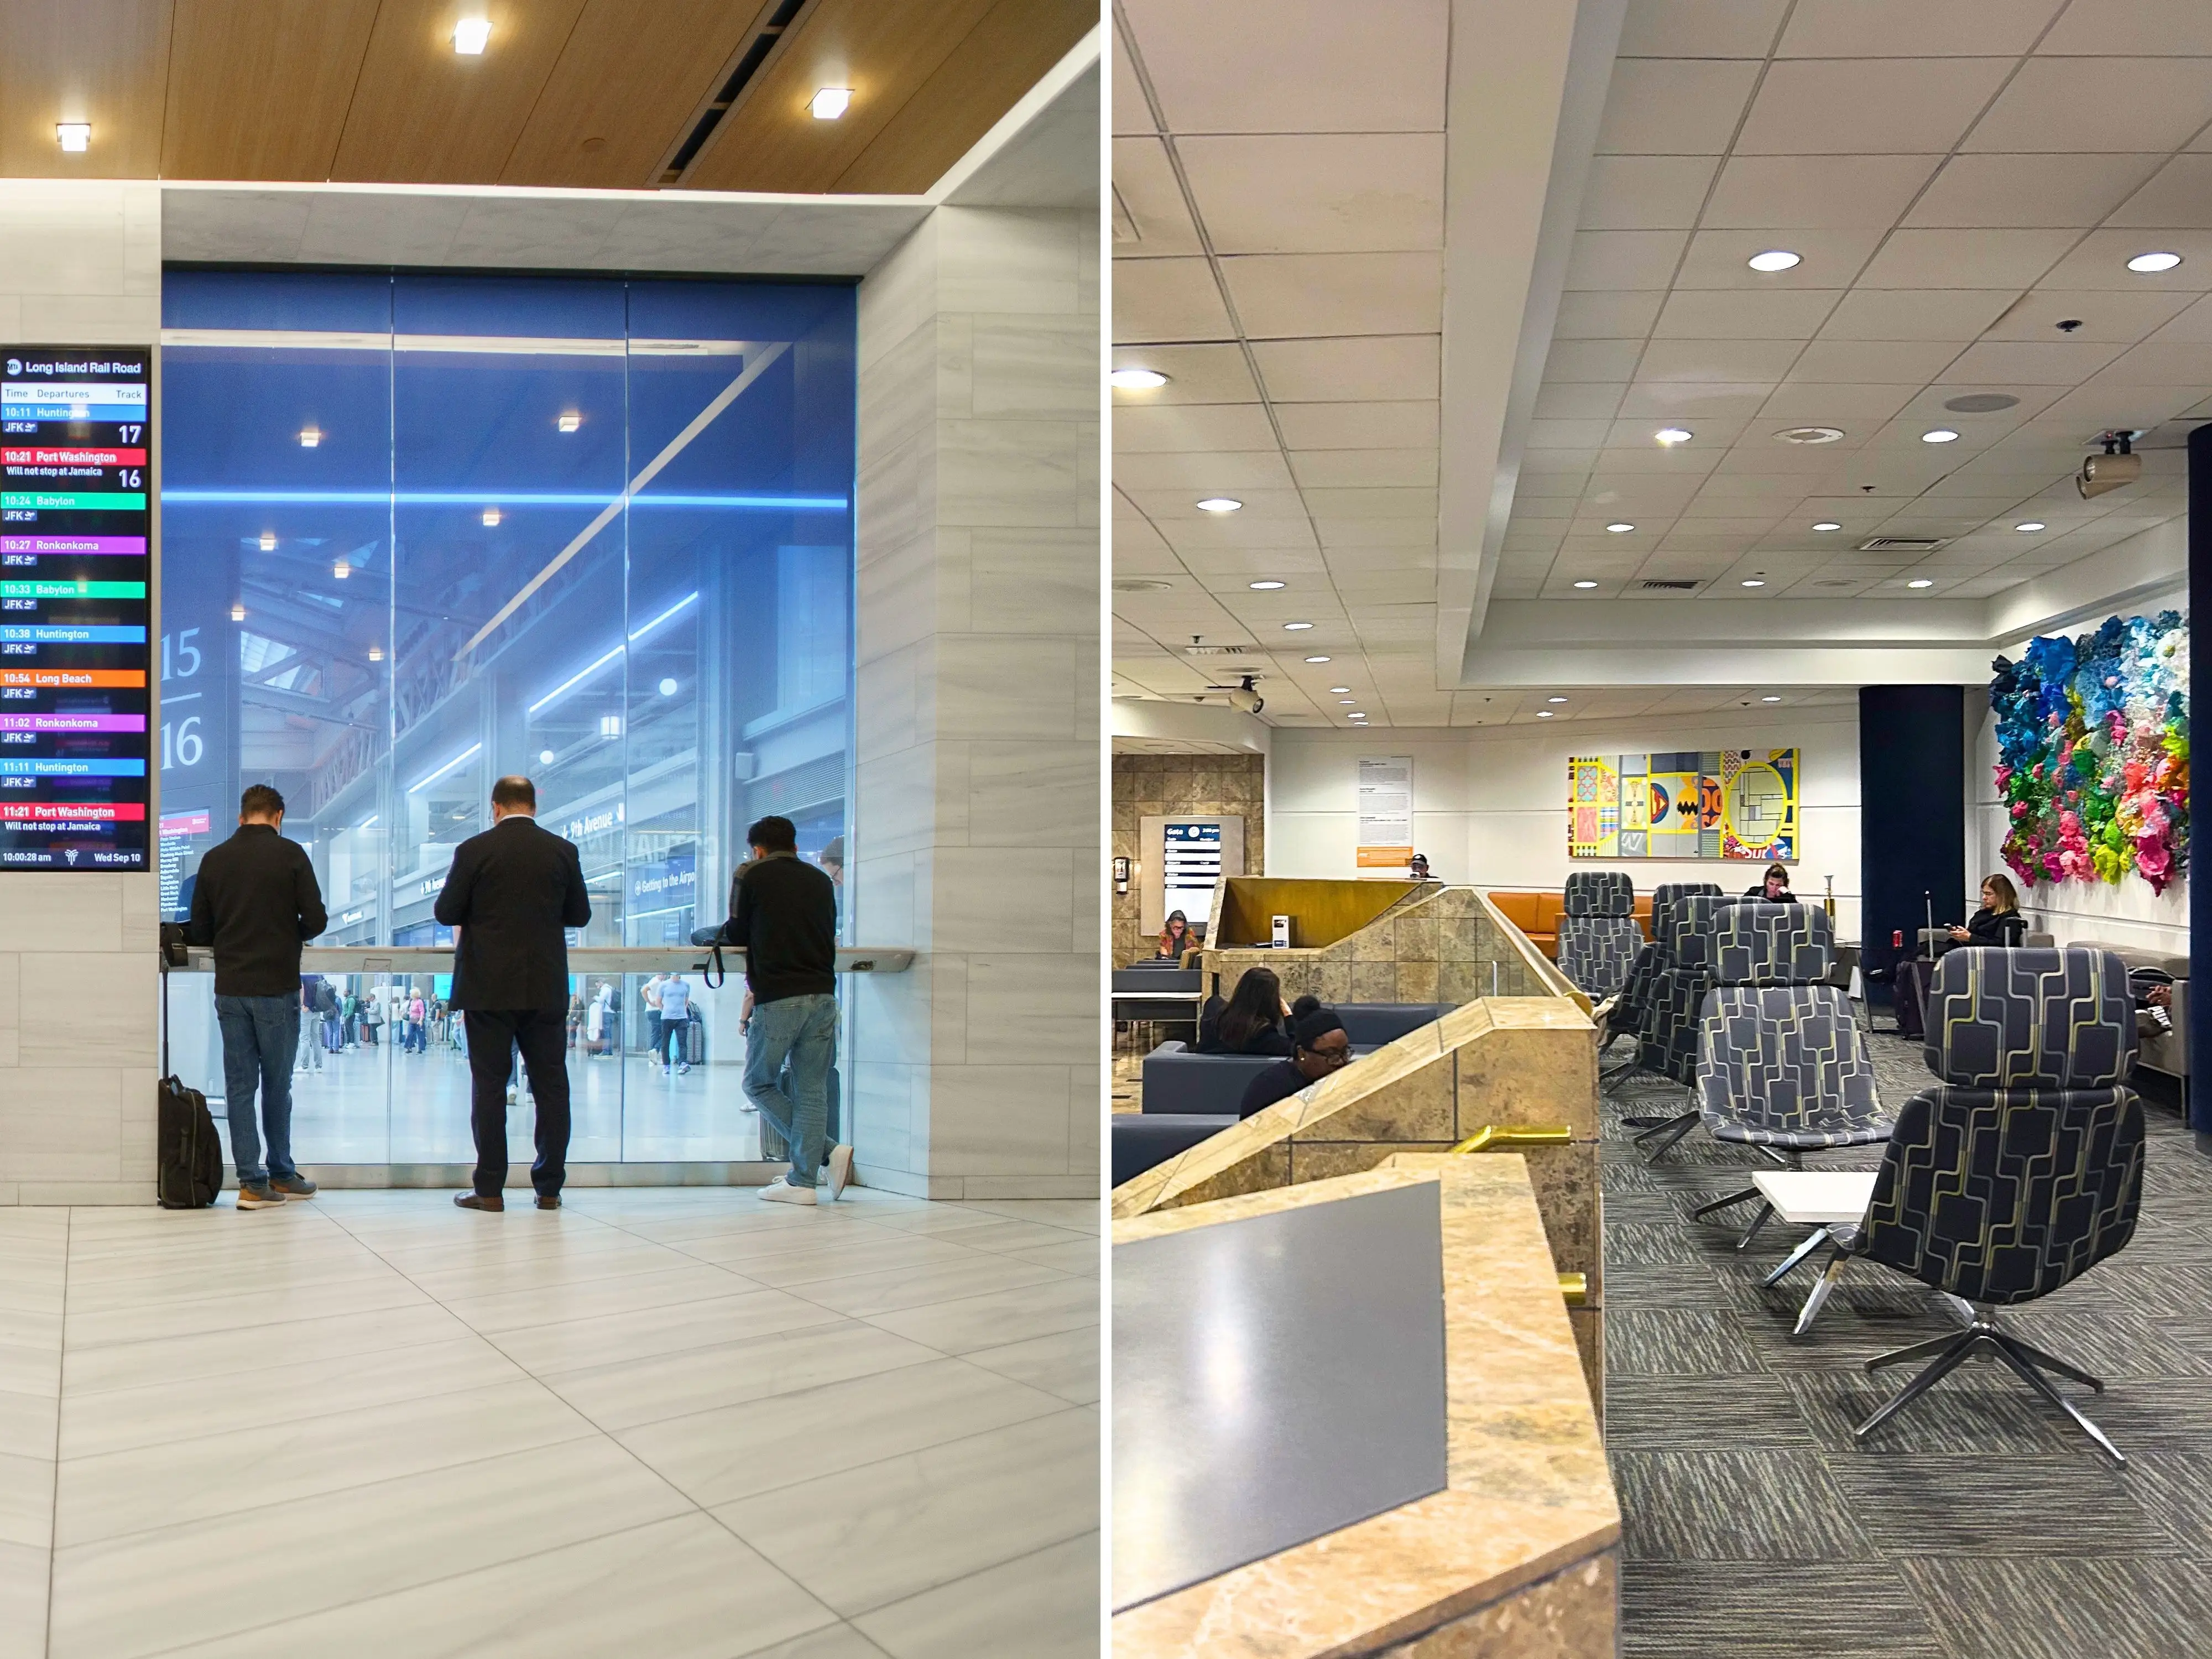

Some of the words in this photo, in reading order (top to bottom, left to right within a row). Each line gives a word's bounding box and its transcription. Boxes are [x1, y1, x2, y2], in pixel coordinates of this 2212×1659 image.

[26, 362, 54, 375] Long
[55, 362, 87, 373] Island
[90, 363, 110, 373] Rail
[112, 363, 141, 374] Road
[6, 389, 28, 398] Time
[37, 389, 90, 399] Departures
[116, 390, 141, 398] Track
[5, 408, 30, 417] 10:11
[37, 408, 90, 419] Huntingn
[5, 422, 24, 432] JFK
[119, 425, 141, 443] 17
[5, 451, 31, 461] 10:21
[36, 451, 58, 461] Port
[59, 451, 117, 464] Washington
[7, 467, 23, 475] Will
[39, 467, 58, 477] stop
[59, 467, 67, 476] at
[69, 467, 102, 476] Jamaica
[119, 469, 141, 487] 16
[5, 496, 30, 505] 10:24
[37, 496, 75, 508] Babylon
[5, 511, 23, 520] JFK
[5, 540, 30, 550] 10:27
[36, 541, 99, 550] Ronkonkoma
[4, 555, 23, 564] JFK
[4, 585, 30, 594] 10:33
[36, 585, 75, 596] Babylon
[4, 600, 23, 609] JFK
[4, 629, 30, 638] 10:38
[36, 629, 88, 640] Huntington
[4, 644, 23, 653] JFK
[160, 627, 201, 681] 15
[4, 674, 30, 682] 10:54
[36, 674, 59, 685] Long
[62, 674, 92, 683] Beach
[4, 688, 23, 697] JFK
[4, 718, 30, 727] 11:02
[36, 718, 98, 727] Ronkonkoma
[4, 733, 23, 742] JFK
[160, 716, 202, 770] 16
[4, 763, 29, 772] 11:11
[35, 763, 88, 774] Huntington
[4, 778, 23, 786] JFK
[3, 807, 29, 816] 11:21
[35, 807, 56, 817] Port
[58, 807, 115, 819] Washington
[5, 822, 22, 830] Will
[38, 822, 56, 832] stop
[66, 822, 101, 831] Jamaica
[571, 819, 583, 839] 9th
[584, 812, 612, 834] Avenue
[3, 853, 37, 862] 10:00:28
[95, 853, 112, 862] Wed
[113, 854, 130, 863] Sep
[642, 879, 661, 893] Getting
[662, 877, 668, 888] to
[669, 874, 679, 886] the
[679, 870, 695, 886] Airpo
